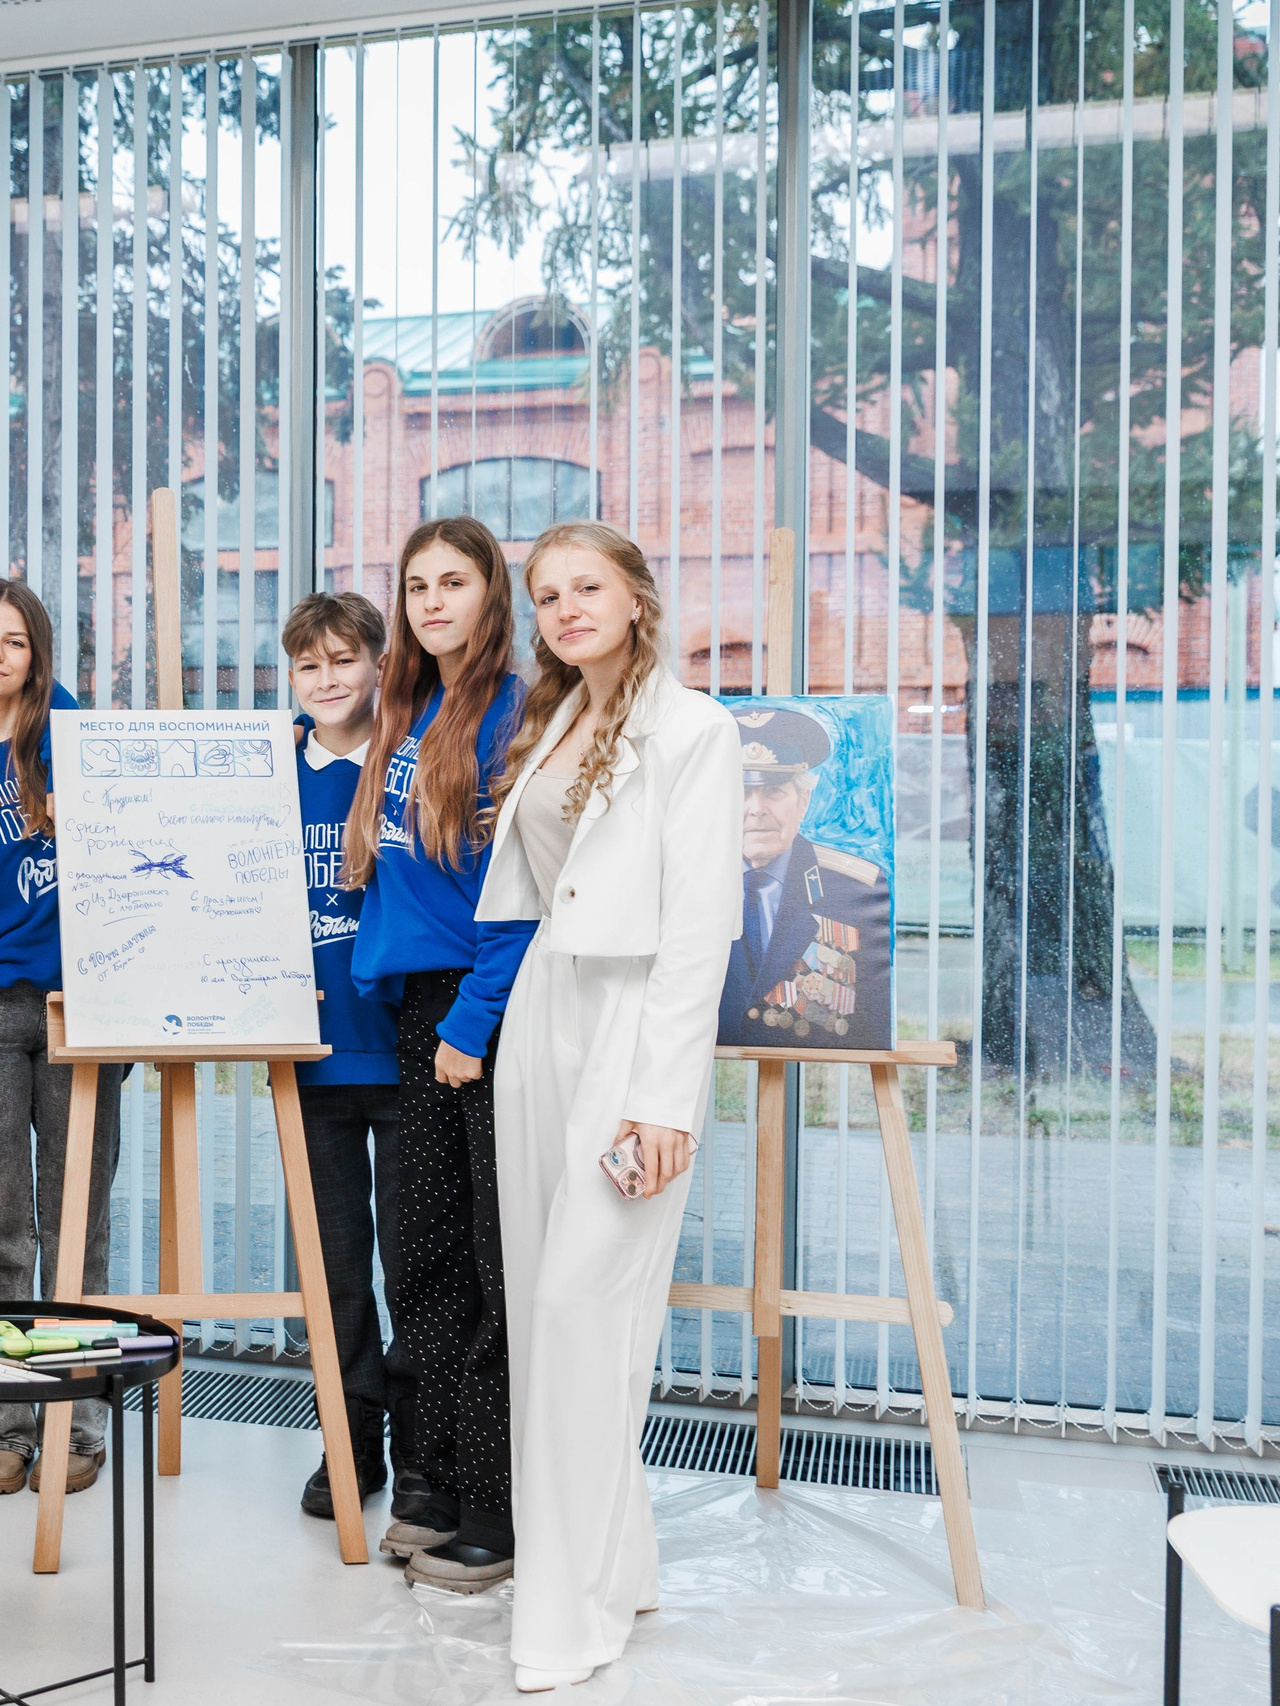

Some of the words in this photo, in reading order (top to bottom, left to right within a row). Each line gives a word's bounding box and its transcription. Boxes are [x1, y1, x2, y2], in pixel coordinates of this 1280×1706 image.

[79, 721, 125, 732] МЕСТО
[128, 721, 155, 733] ДЛЯ
[159, 719, 271, 732] ВОСПОМИНАНИЙ
[186, 1014, 226, 1022] ВОЛОНТЁРЫ
